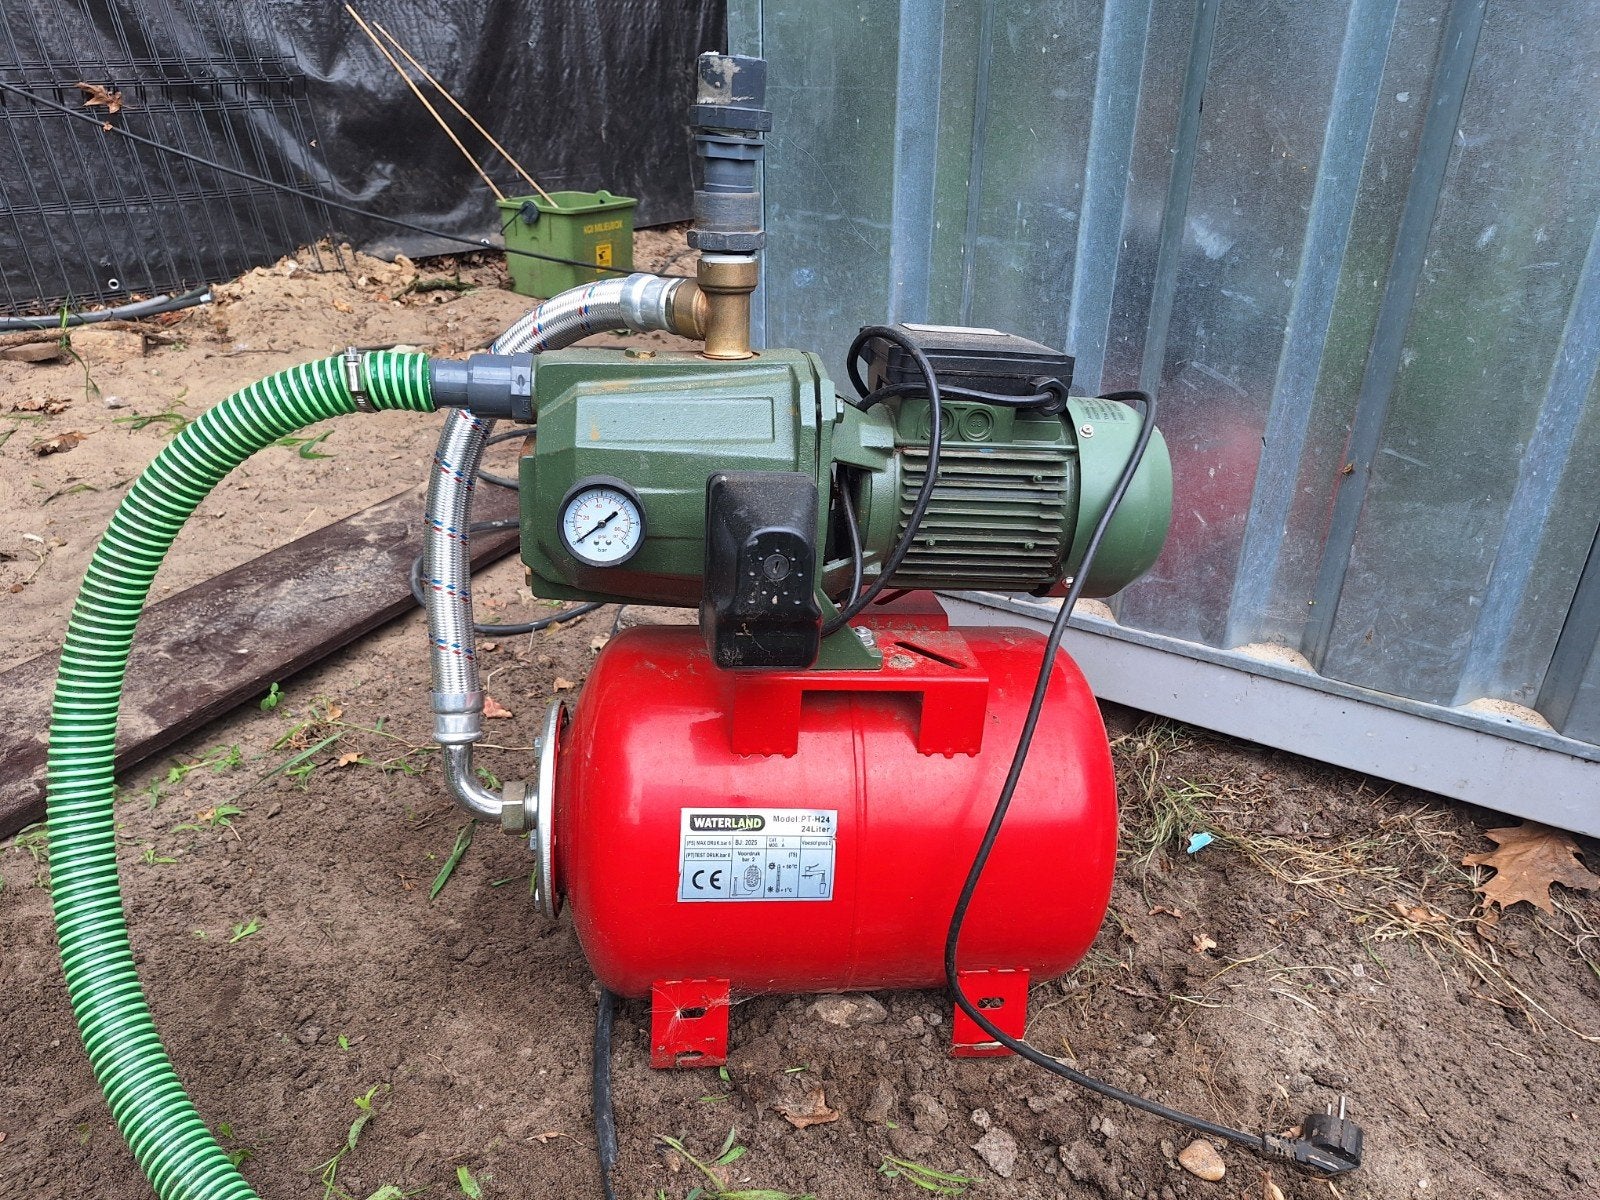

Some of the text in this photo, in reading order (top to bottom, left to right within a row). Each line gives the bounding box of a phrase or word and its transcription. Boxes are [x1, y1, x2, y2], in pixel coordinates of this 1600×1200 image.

[693, 817, 762, 828] WATERLAND
[801, 825, 831, 833] 24Liter
[692, 870, 722, 890] CE
